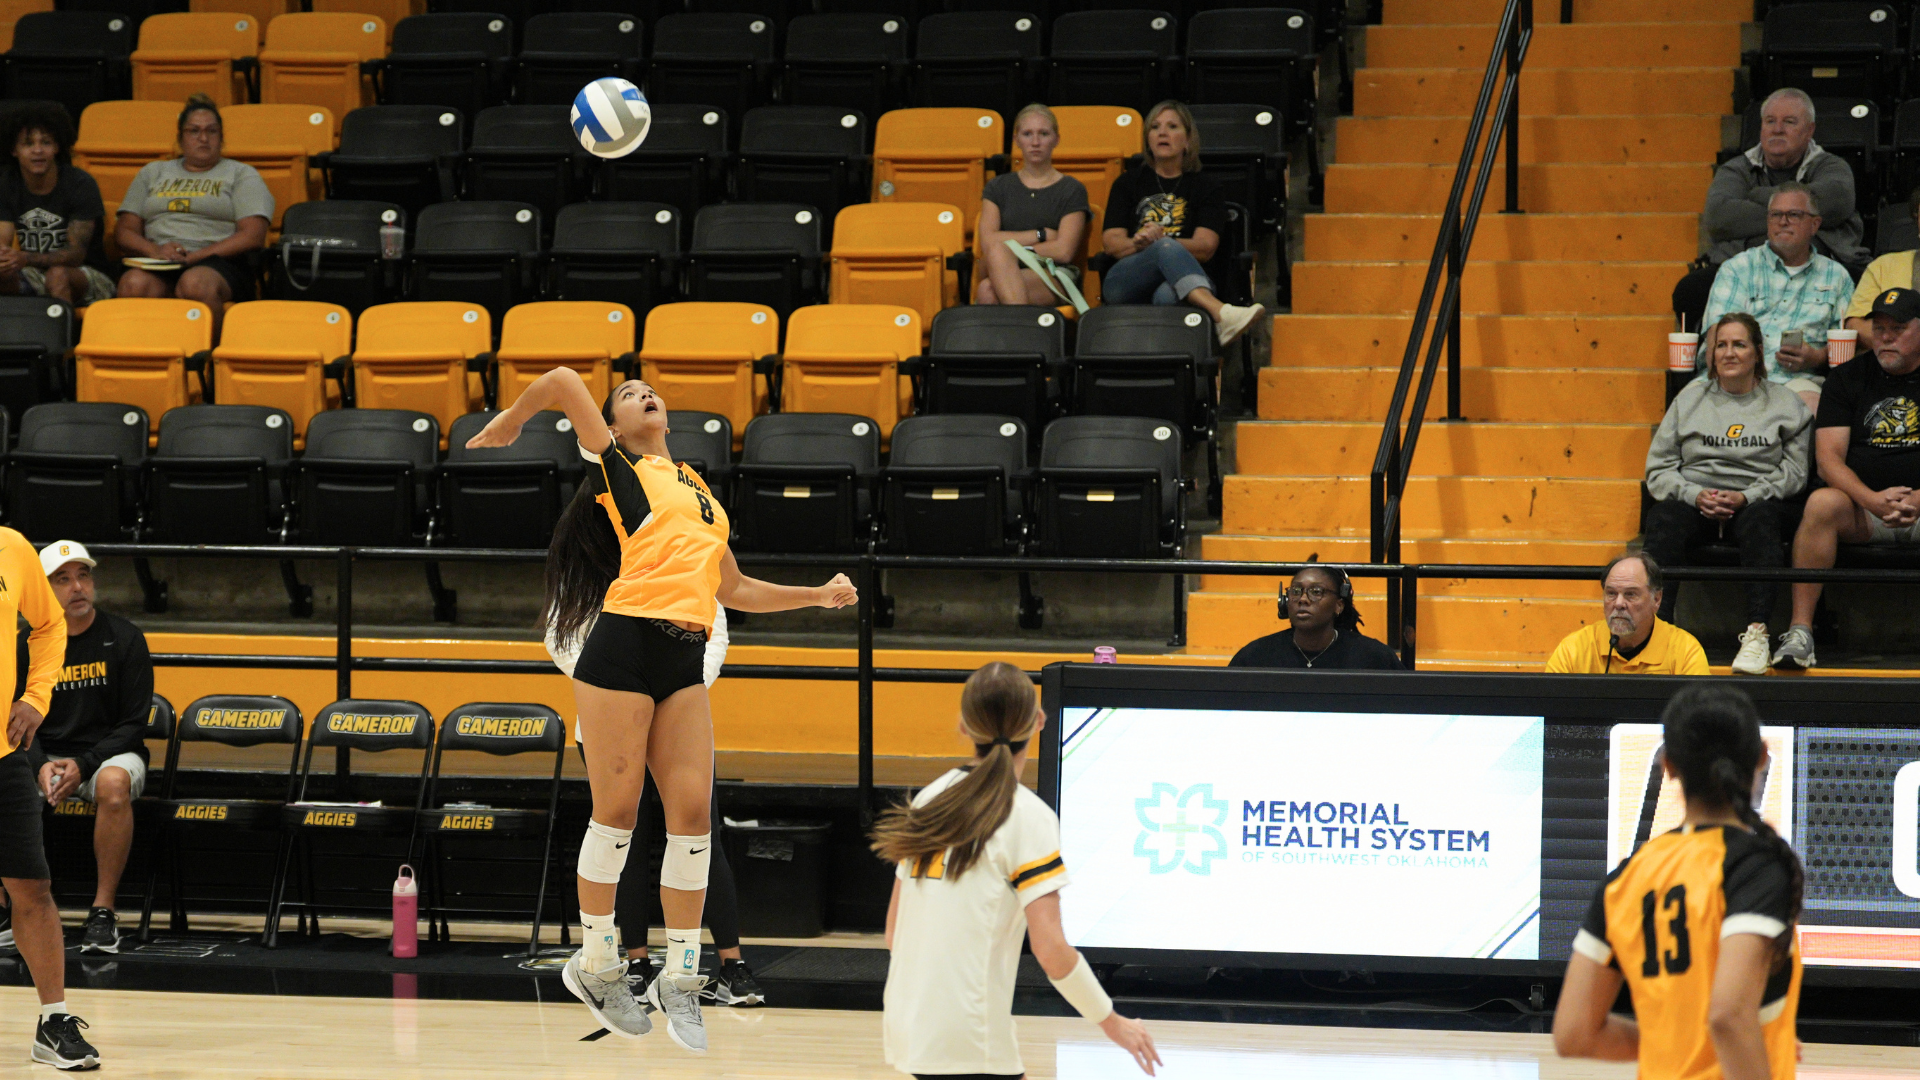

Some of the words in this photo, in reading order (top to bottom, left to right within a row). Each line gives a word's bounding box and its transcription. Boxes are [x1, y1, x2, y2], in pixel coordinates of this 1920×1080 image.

[695, 492, 715, 526] 8
[59, 661, 106, 682] MERON
[196, 709, 285, 728] CAMERON
[329, 713, 416, 734] CAMERON
[457, 717, 546, 736] CAMERON
[54, 801, 97, 815] AGGIE
[175, 805, 227, 820] AGGIES
[1243, 799, 1409, 825] MEMORIAL
[303, 811, 357, 827] AGGIES
[440, 815, 494, 830] AGGIES
[1242, 825, 1360, 848] HEALTH
[1371, 828, 1489, 852] SYSTEM
[1242, 851, 1264, 864] OF
[1271, 852, 1380, 867] SOUTHWEST
[1387, 854, 1489, 869] OKLAHOMA
[1641, 884, 1692, 979] 13
